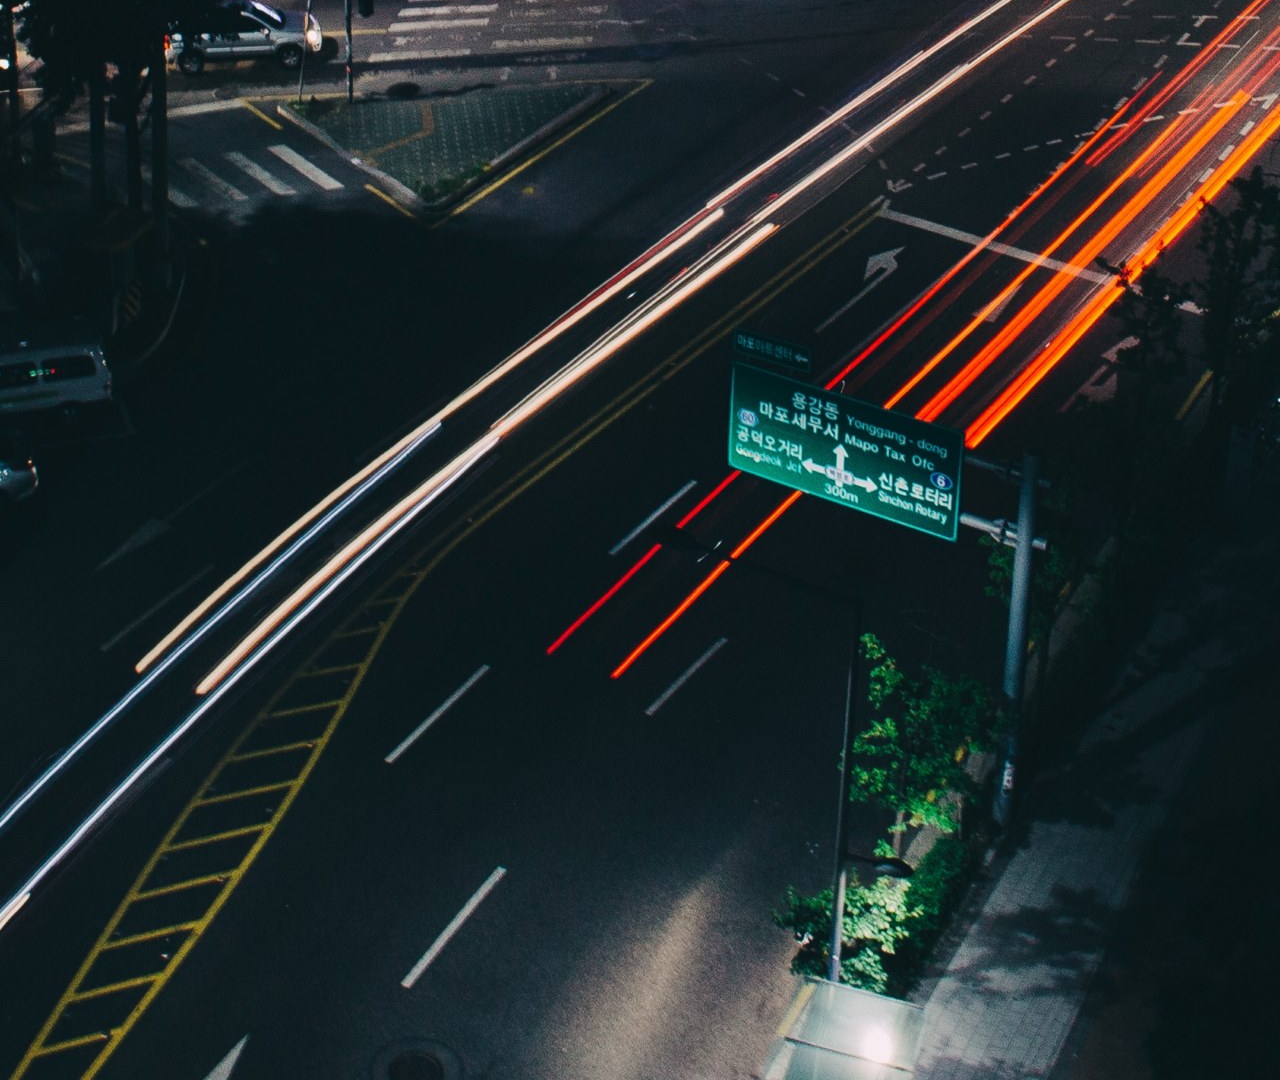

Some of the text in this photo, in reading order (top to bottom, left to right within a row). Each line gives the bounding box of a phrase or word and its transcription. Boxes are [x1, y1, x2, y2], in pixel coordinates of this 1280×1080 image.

[760, 400, 839, 441] 마포세무서
[792, 392, 840, 420] 용강동
[736, 424, 803, 461] 공덕오거리
[844, 432, 879, 453] Mapo
[883, 445, 906, 463] Tax
[824, 482, 859, 504] 300m
[877, 490, 948, 525] Sinchon Rotary
[878, 471, 953, 511] 신촌로터리
